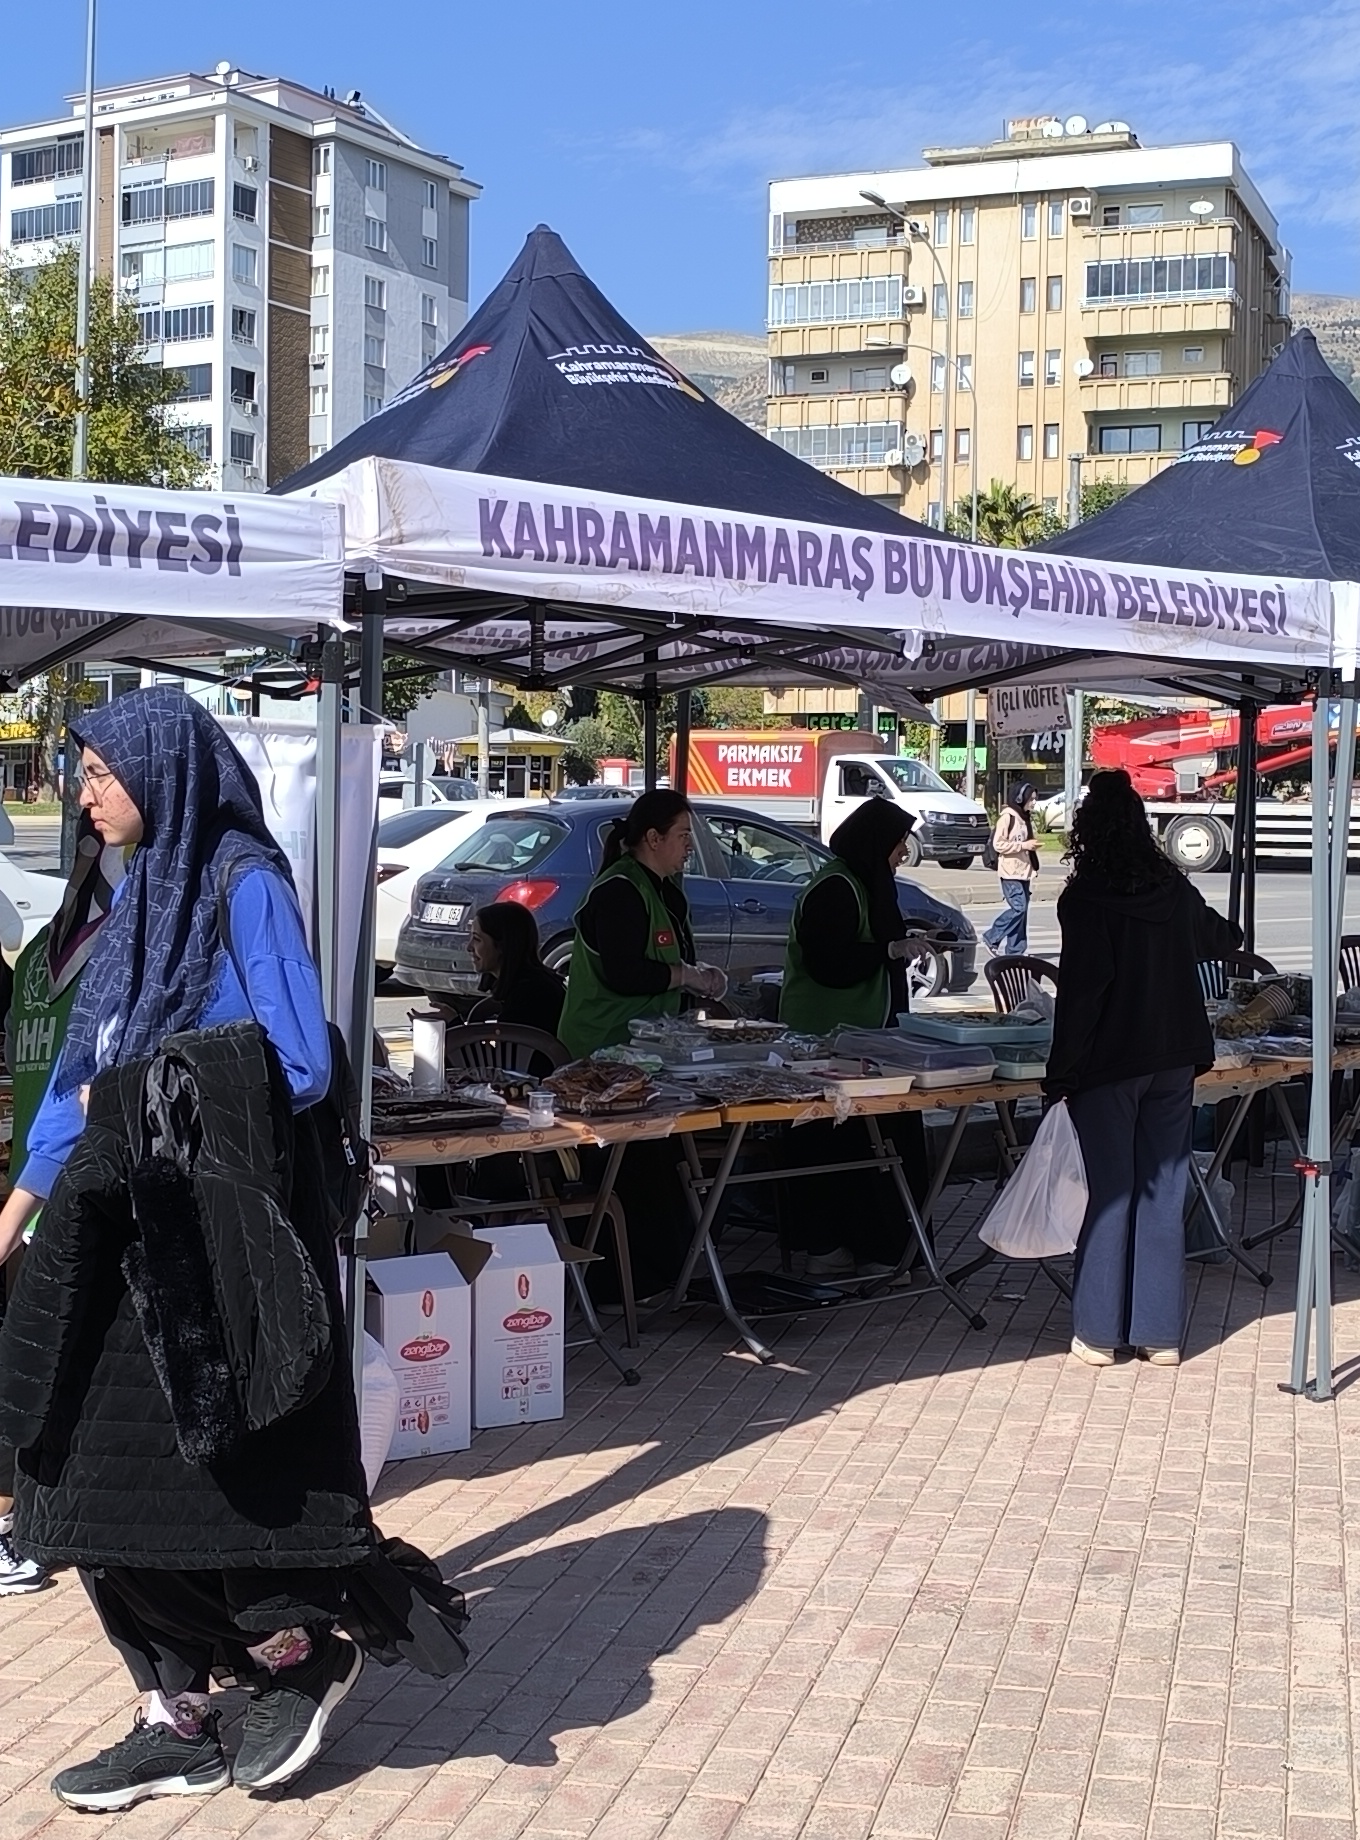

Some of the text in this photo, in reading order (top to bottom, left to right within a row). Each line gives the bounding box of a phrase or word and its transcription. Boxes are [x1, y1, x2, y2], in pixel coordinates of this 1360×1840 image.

[478, 497, 1288, 637] KAHRAMANMARAŞ BÜYÜKŞEHİR BELEDİYESİ
[996, 684, 1060, 718] İÇLİ KÖFTE
[810, 713, 896, 731] cerezm
[718, 744, 803, 764] PARMAKSIZ
[727, 768, 792, 788] EKMEK
[506, 1314, 549, 1329] zengibar
[403, 1342, 447, 1357] zengibar
